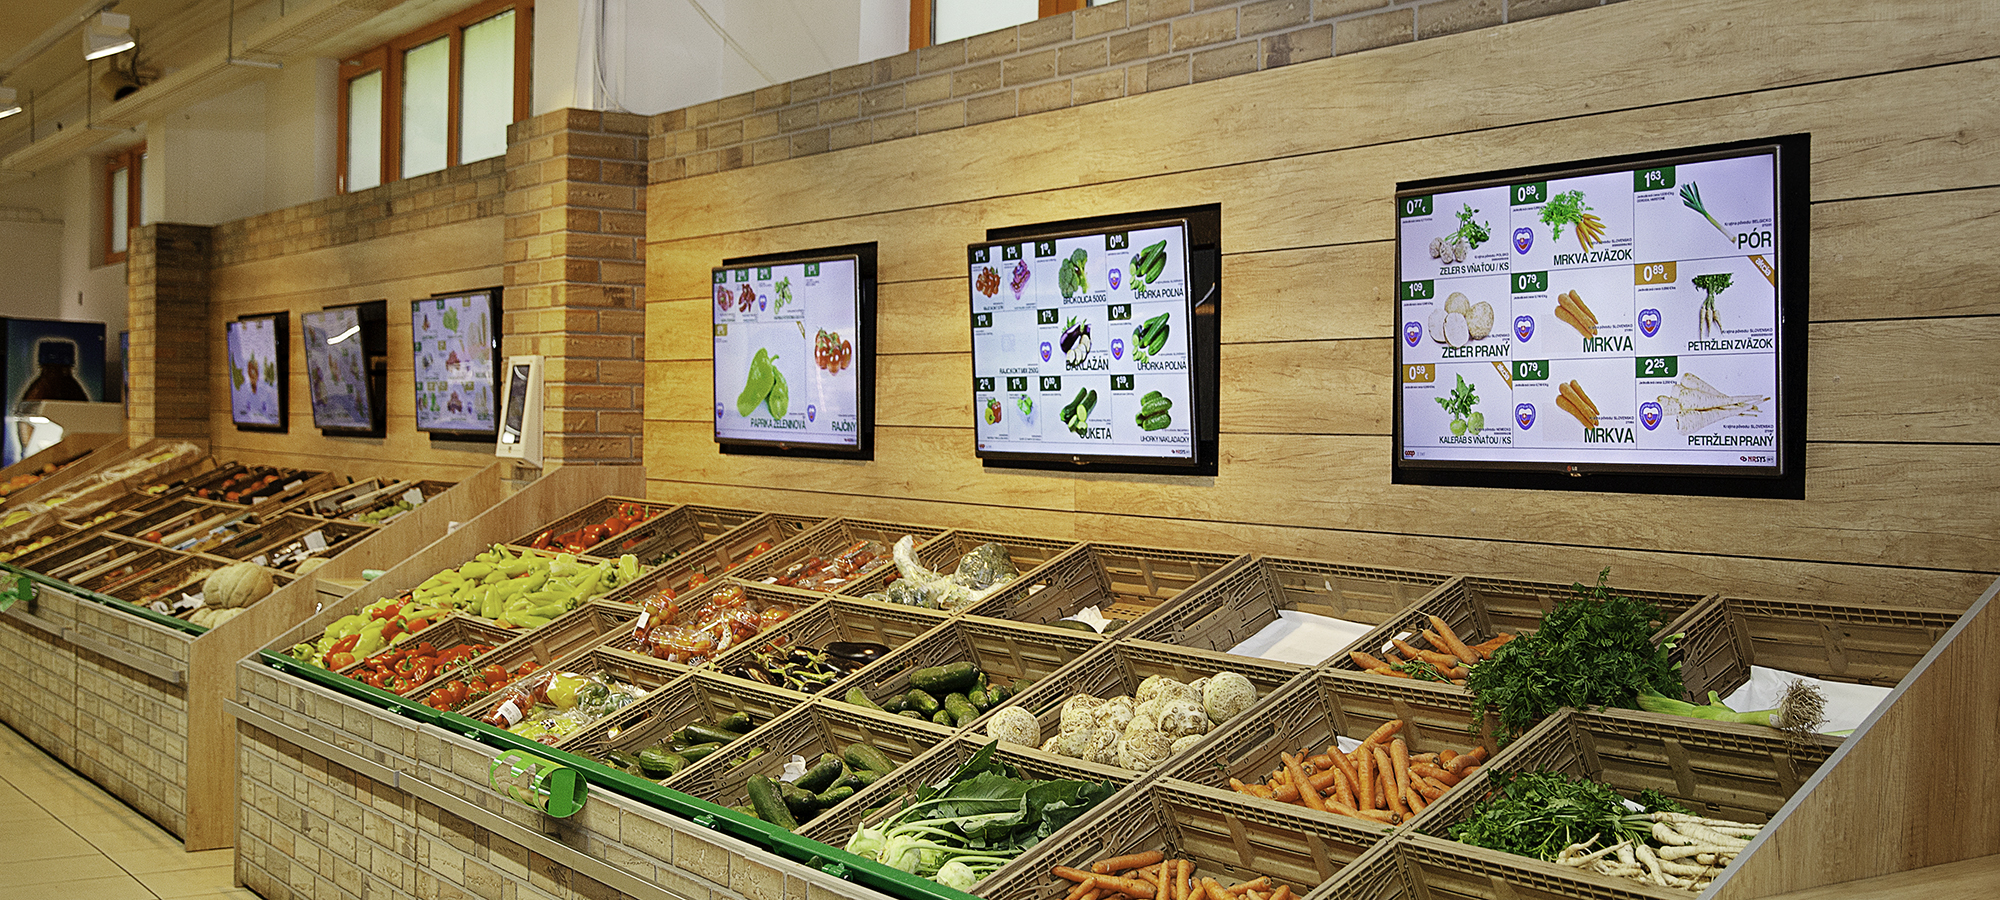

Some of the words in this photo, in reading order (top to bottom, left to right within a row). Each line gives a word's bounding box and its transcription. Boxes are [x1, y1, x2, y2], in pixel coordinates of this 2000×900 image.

[1738, 227, 1772, 250] PÓR
[1553, 252, 1589, 266] MRKVA
[1590, 248, 1633, 263] ZVÄZOK
[1439, 266, 1460, 276] ZELER
[1461, 265, 1466, 274] S
[1499, 261, 1509, 271] KS
[1441, 345, 1473, 358] ZELER
[1475, 341, 1510, 357] PRANÝ
[1583, 335, 1634, 353] MRKVA
[1688, 338, 1733, 351] PETRŽLEN
[1734, 337, 1773, 350] ZVÄZOK
[1467, 435, 1472, 444] S
[1502, 436, 1512, 445] KS
[1584, 427, 1635, 443] MRKVA
[1688, 432, 1738, 446] PETRŽLEN
[1739, 432, 1774, 447] PRANÝ
